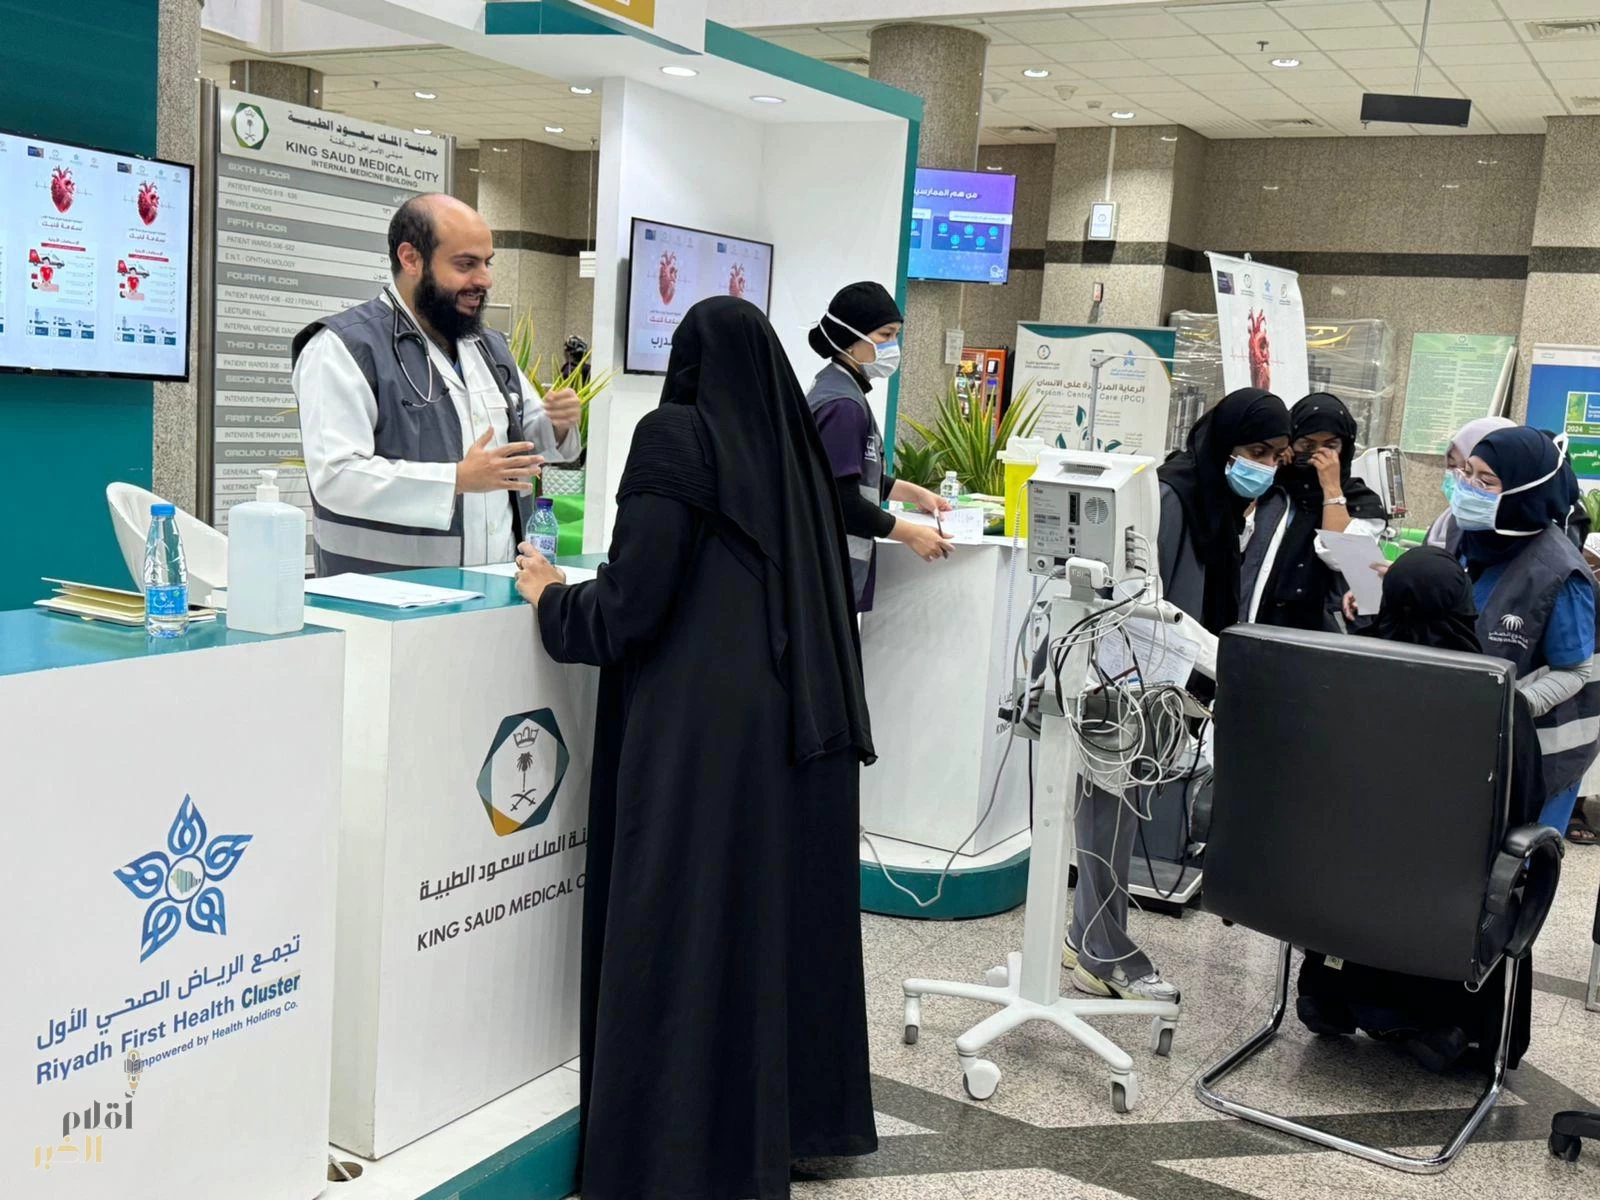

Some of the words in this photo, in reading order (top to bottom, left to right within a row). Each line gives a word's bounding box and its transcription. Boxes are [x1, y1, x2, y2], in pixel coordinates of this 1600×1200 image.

[336, 124, 374, 141] سعود
[377, 134, 402, 147] الملك
[286, 141, 318, 156] KING
[321, 148, 355, 165] SAUD
[359, 157, 411, 177] MEDICAL
[414, 169, 439, 183] CITY
[228, 162, 257, 174] SIXTH
[259, 168, 290, 180] FLOOR
[311, 159, 348, 174] INTERNAL
[350, 167, 384, 181] MEDICINE
[385, 174, 418, 188] BUILDING
[913, 188, 950, 197] الممارسي
[227, 217, 254, 228] FIFTH
[256, 221, 288, 233] FLOOR
[226, 271, 265, 283] FOURTH
[267, 275, 299, 286] FLOOR
[224, 306, 251, 315] LECTURE
[252, 309, 266, 317] HALL
[226, 340, 255, 350] THIRD
[257, 342, 288, 351] FLOOR
[225, 375, 265, 384] SECOND
[268, 377, 292, 385] FLOO
[1063, 380, 1082, 389] على
[1119, 383, 1146, 393] الرعاية
[1067, 390, 1094, 400] Centre
[1100, 392, 1117, 401] Care
[224, 414, 252, 422] FIRST
[254, 415, 285, 423] FLOOR
[1566, 425, 1583, 433] 2024
[224, 449, 266, 457] GROUND
[268, 449, 299, 457] FLOOR
[222, 468, 250, 476] GENERAL
[222, 483, 249, 491] MEETING
[528, 834, 566, 862] الملك
[478, 851, 525, 882] سعود
[419, 864, 475, 901] الطبية
[417, 921, 460, 951] KING
[464, 904, 506, 933] SAUD
[509, 878, 573, 916] MEDICAL
[251, 934, 300, 974] تجمع
[178, 954, 244, 1000] الرياض
[96, 979, 170, 1036] الصحي
[36, 1040, 113, 1085] Riyadh
[121, 1021, 166, 1053] First
[173, 996, 235, 1033] Health
[241, 974, 301, 1009] Cluster
[37, 1007, 88, 1050] الأول
[196, 1034, 209, 1046] by
[212, 1020, 243, 1040] Health
[246, 1005, 281, 1027] Holding
[284, 1000, 298, 1012] Co.
